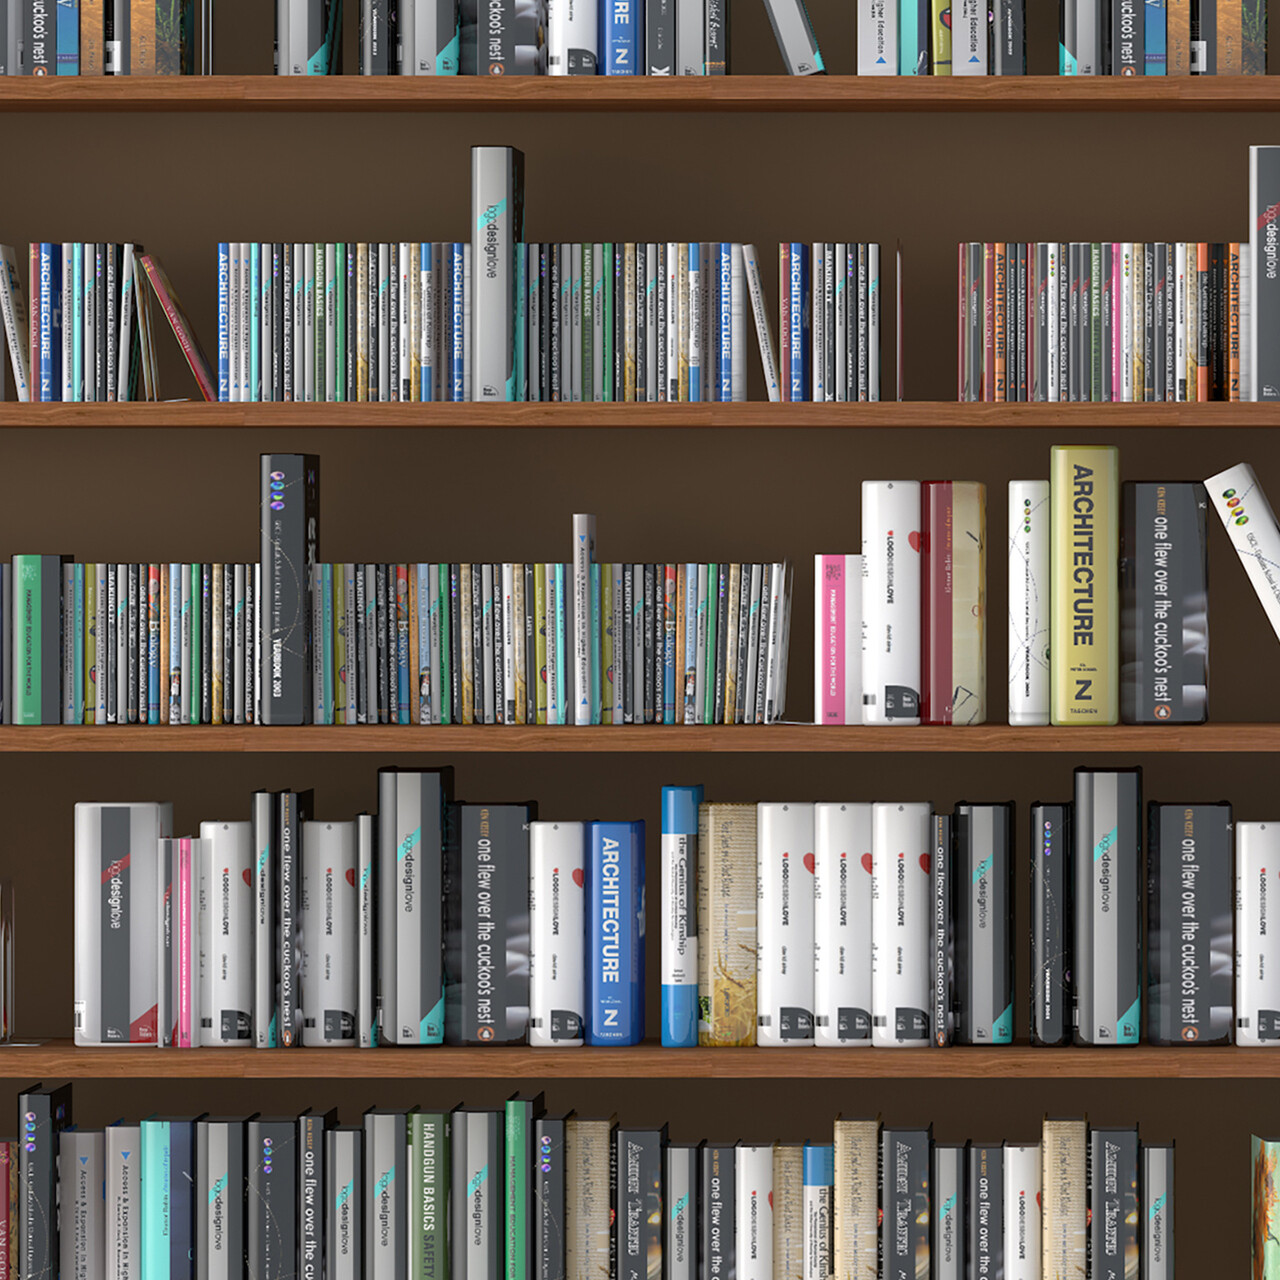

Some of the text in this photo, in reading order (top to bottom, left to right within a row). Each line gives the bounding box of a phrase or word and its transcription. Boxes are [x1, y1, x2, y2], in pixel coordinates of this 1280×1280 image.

[33, 41, 47, 64] nest
[42, 252, 50, 359] ARCHITECTURE
[220, 253, 228, 359] ARCHITECTURE
[792, 252, 800, 359] ARCHITECTURE
[996, 253, 1004, 359] ARCHITECTURE
[1073, 464, 1093, 646] ARCHITECTURE
[1154, 517, 1172, 702] one flew over the cuckoo's nest
[272, 639, 282, 678] YEARBOOK
[272, 680, 282, 697] 2003
[477, 839, 491, 861] one
[403, 834, 414, 912] logodesignlove
[477, 865, 495, 888] flew
[1099, 834, 1111, 912] logodesignlove
[477, 892, 491, 918] over
[602, 838, 619, 983] ARCHITECTURE
[679, 899, 687, 910] of
[477, 922, 495, 940] the
[677, 914, 686, 955] Kinship
[1182, 839, 1199, 1024] one flew over the cuckoo's nest
[477, 944, 494, 995] cuckoo's
[477, 999, 493, 1024] nest
[305, 1151, 315, 1175] one
[423, 1123, 434, 1183] HANDGUN
[305, 1180, 316, 1204] flew
[423, 1187, 434, 1231] BASICS
[819, 1188, 828, 1204] the
[121, 1207, 129, 1249] Expansion
[305, 1208, 315, 1236] over
[819, 1206, 828, 1240] Genius
[305, 1240, 316, 1260] the
[423, 1234, 434, 1278] SAFETY
[819, 1242, 828, 1252] of
